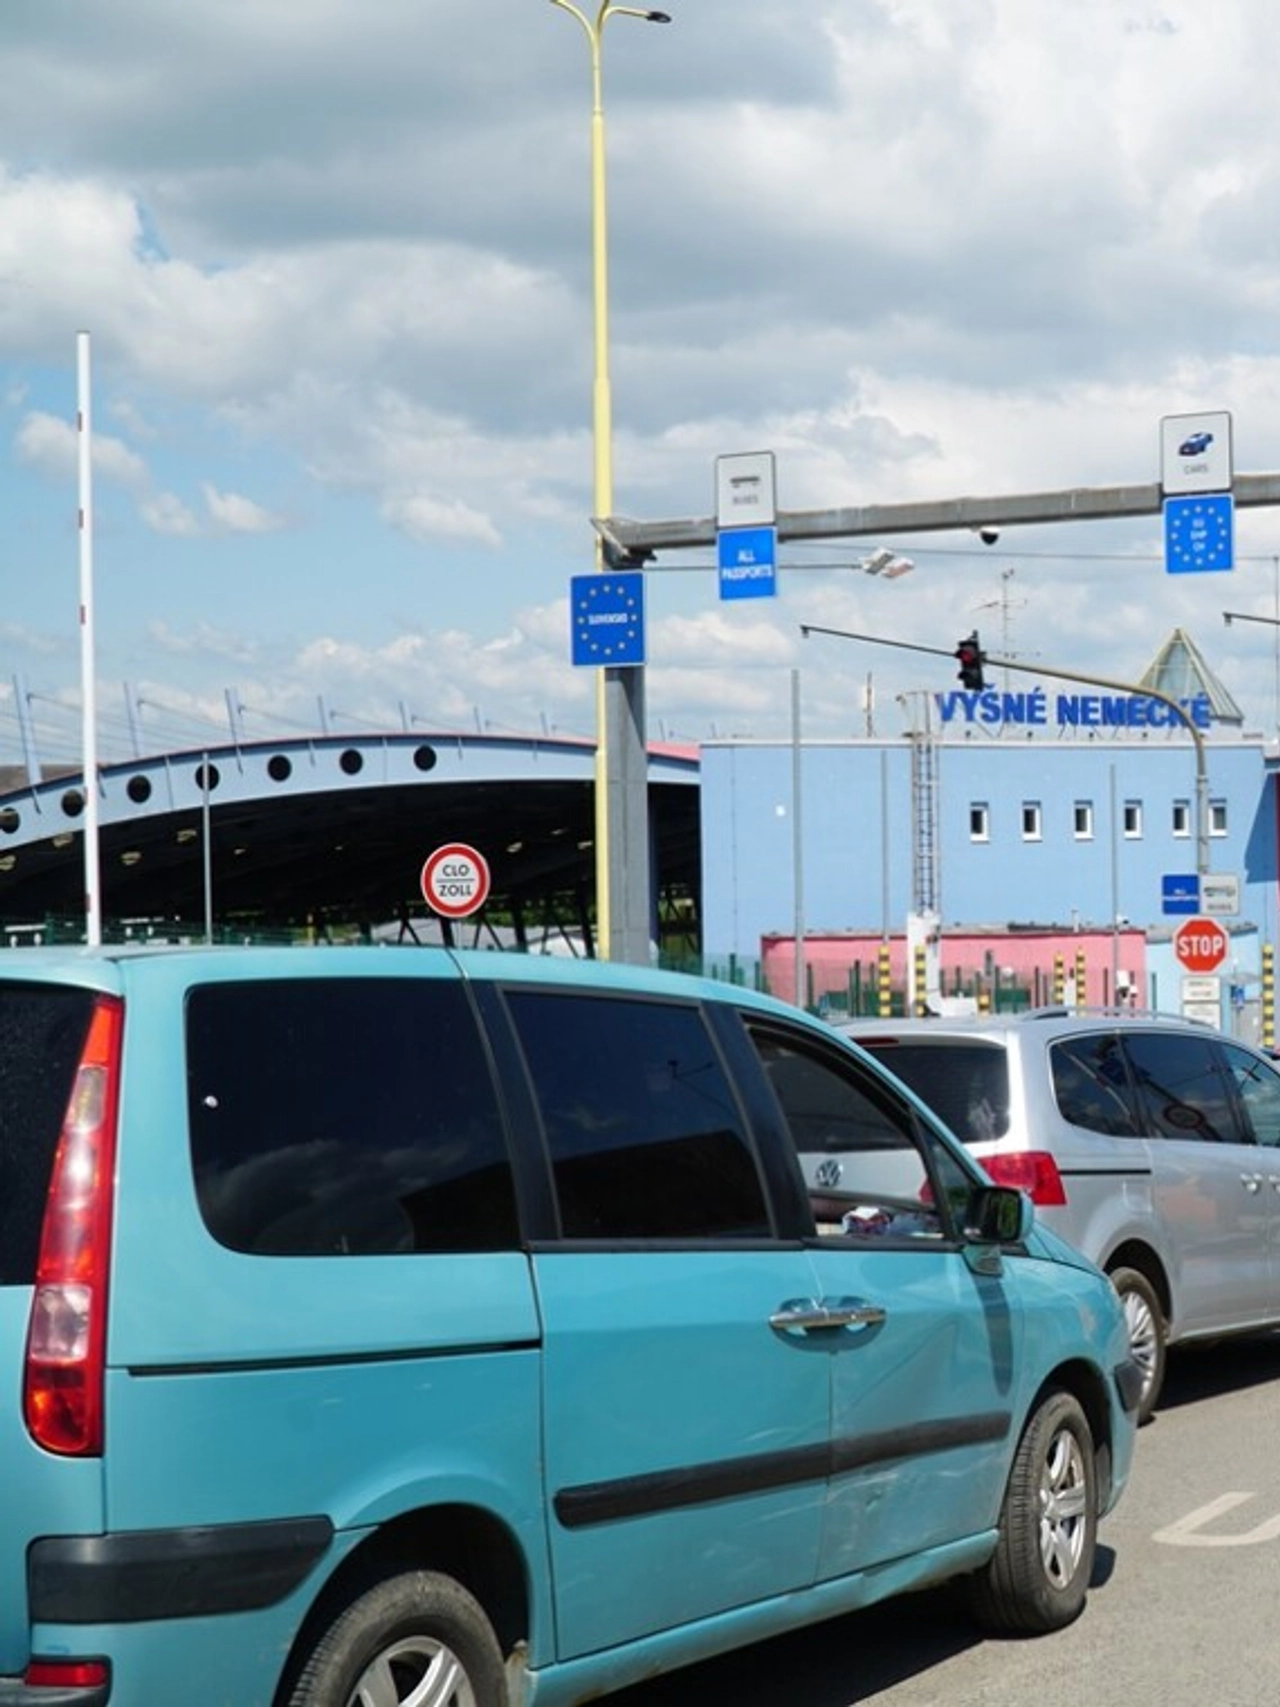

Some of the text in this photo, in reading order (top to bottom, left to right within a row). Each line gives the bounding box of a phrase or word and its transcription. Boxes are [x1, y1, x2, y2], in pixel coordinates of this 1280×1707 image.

[934, 684, 1047, 724] VYŠNÉ
[442, 864, 470, 877] CLO
[439, 884, 472, 897] ZOLL
[1178, 936, 1224, 957] STOP
